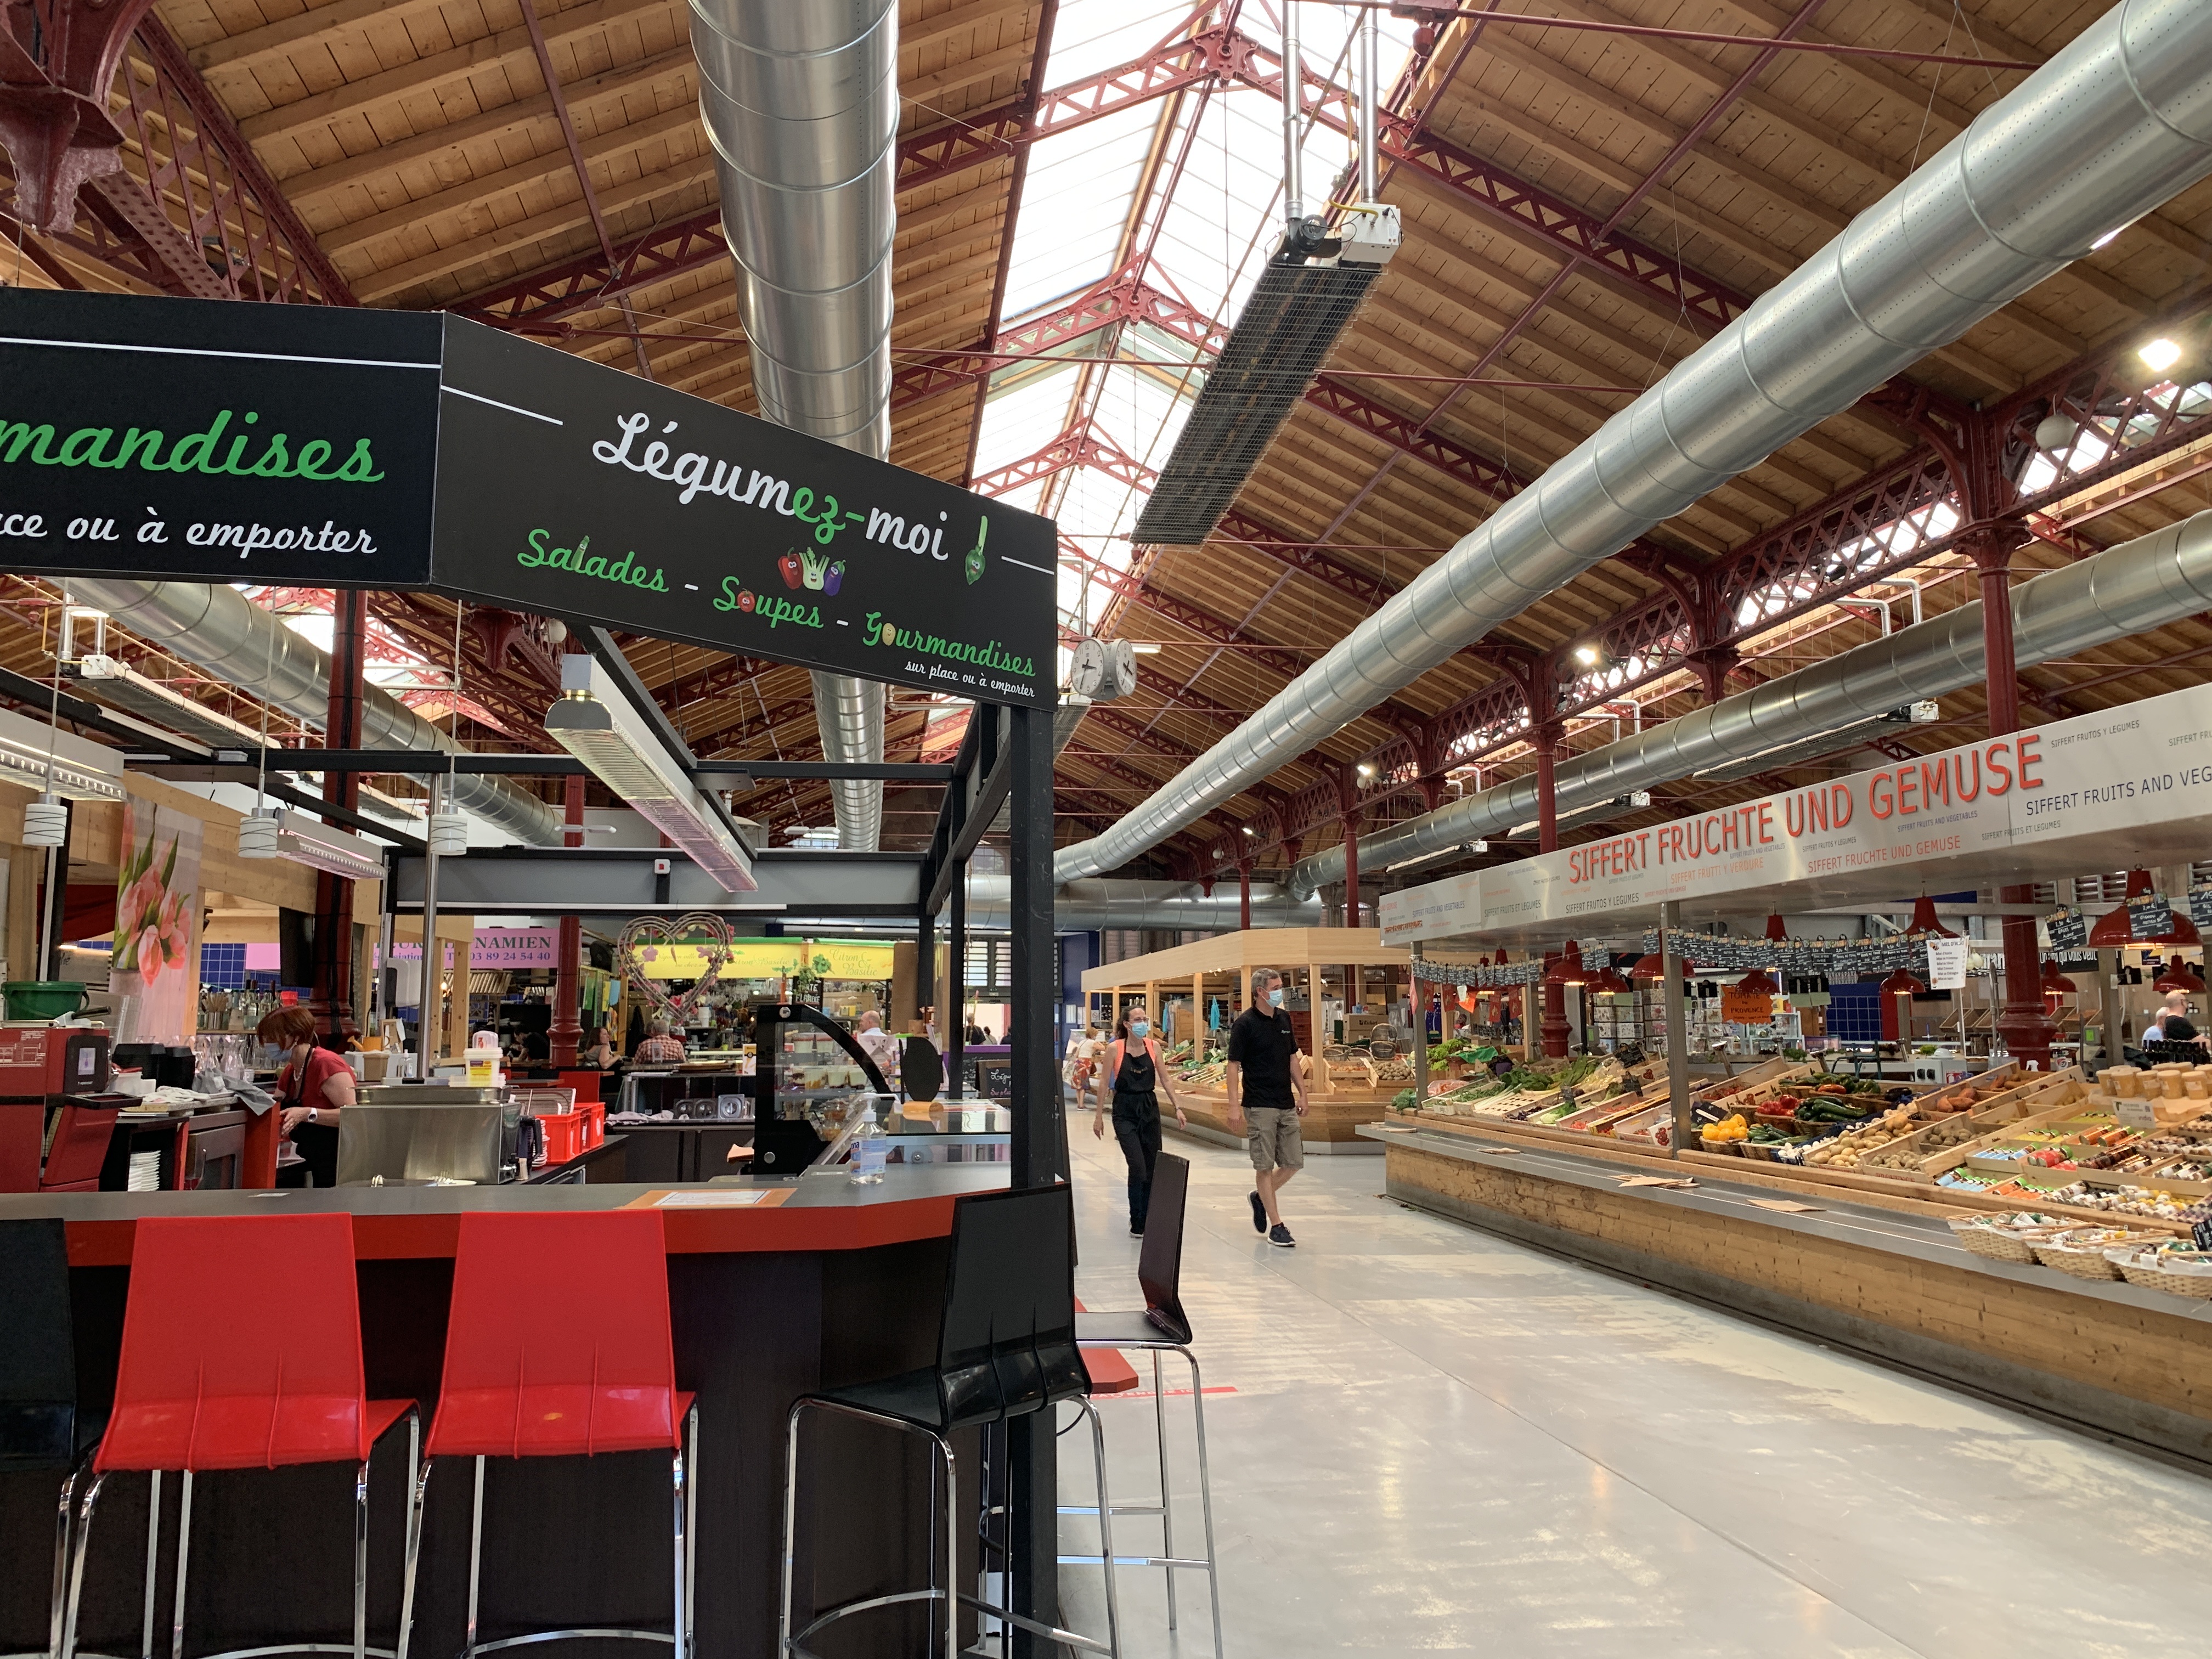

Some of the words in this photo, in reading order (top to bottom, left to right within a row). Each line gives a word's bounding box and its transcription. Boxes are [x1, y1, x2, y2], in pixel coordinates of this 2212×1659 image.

[592, 413, 949, 561] Légumez-moi
[67, 517, 119, 540] ou
[137, 507, 168, 543] à
[187, 521, 377, 558] emporter
[905, 661, 926, 674] sur
[928, 664, 959, 679] place
[962, 674, 976, 684] ou
[979, 673, 987, 686] à
[990, 680, 1035, 697] emporter
[2051, 735, 2075, 748] SIFFERT
[2076, 729, 2101, 741] FRUTOS
[2109, 720, 2140, 734] LEGUMES
[2168, 732, 2197, 747] SIFFERT
[2026, 793, 2078, 816] SIFFERT
[2084, 782, 2135, 805] FRUITS
[2141, 774, 2173, 794] AND
[2179, 766, 2212, 786] VEG
[1569, 833, 1649, 884] SIFFERT
[1658, 802, 1774, 865] FRUCHTE
[1785, 783, 1853, 837] UND
[1869, 734, 2045, 820] GEMUSE
[1897, 821, 1915, 832] SIFFERT
[1916, 819, 1934, 828] FRUITS
[1934, 816, 1945, 825] AND
[1946, 810, 1978, 823] VEGETABLES
[1982, 830, 2002, 840] SIFFERT
[2004, 826, 2024, 837] FRUITS
[2025, 825, 2032, 833] ET
[2034, 820, 2061, 832] LEGUMES
[1802, 843, 1817, 853] SIFFERT
[1818, 840, 1833, 850] FRUTOS
[1838, 836, 1857, 846] LEGUMES
[1808, 856, 1842, 873] SIFFERT
[1845, 848, 1887, 866] FRUCHTE
[1891, 844, 1912, 859] UND
[1916, 835, 1961, 855] GEMUSE
[1671, 870, 1696, 884] SIFFERT
[1698, 865, 1721, 878] FRUTTI
[1723, 865, 1728, 874] Y
[1729, 857, 1764, 873] VERDURE
[1484, 907, 1499, 917] SIFFERT
[1500, 904, 1514, 914] FRUITS
[1515, 904, 1520, 912] ET
[1521, 900, 1541, 911] LEGUMES
[1566, 902, 1585, 914] SIFFERT
[1587, 898, 1606, 910] FRUTOS
[1608, 898, 1611, 906] Y
[1613, 893, 1639, 906] LEGUMES
[473, 936, 551, 949] NAMIEN
[486, 952, 499, 961] 89
[503, 952, 516, 961] 24
[520, 952, 533, 961] 54
[537, 952, 550, 961] 40
[830, 948, 859, 961] Citron
[842, 963, 878, 976] Basilic
[990, 1069, 1011, 1084] Légu
